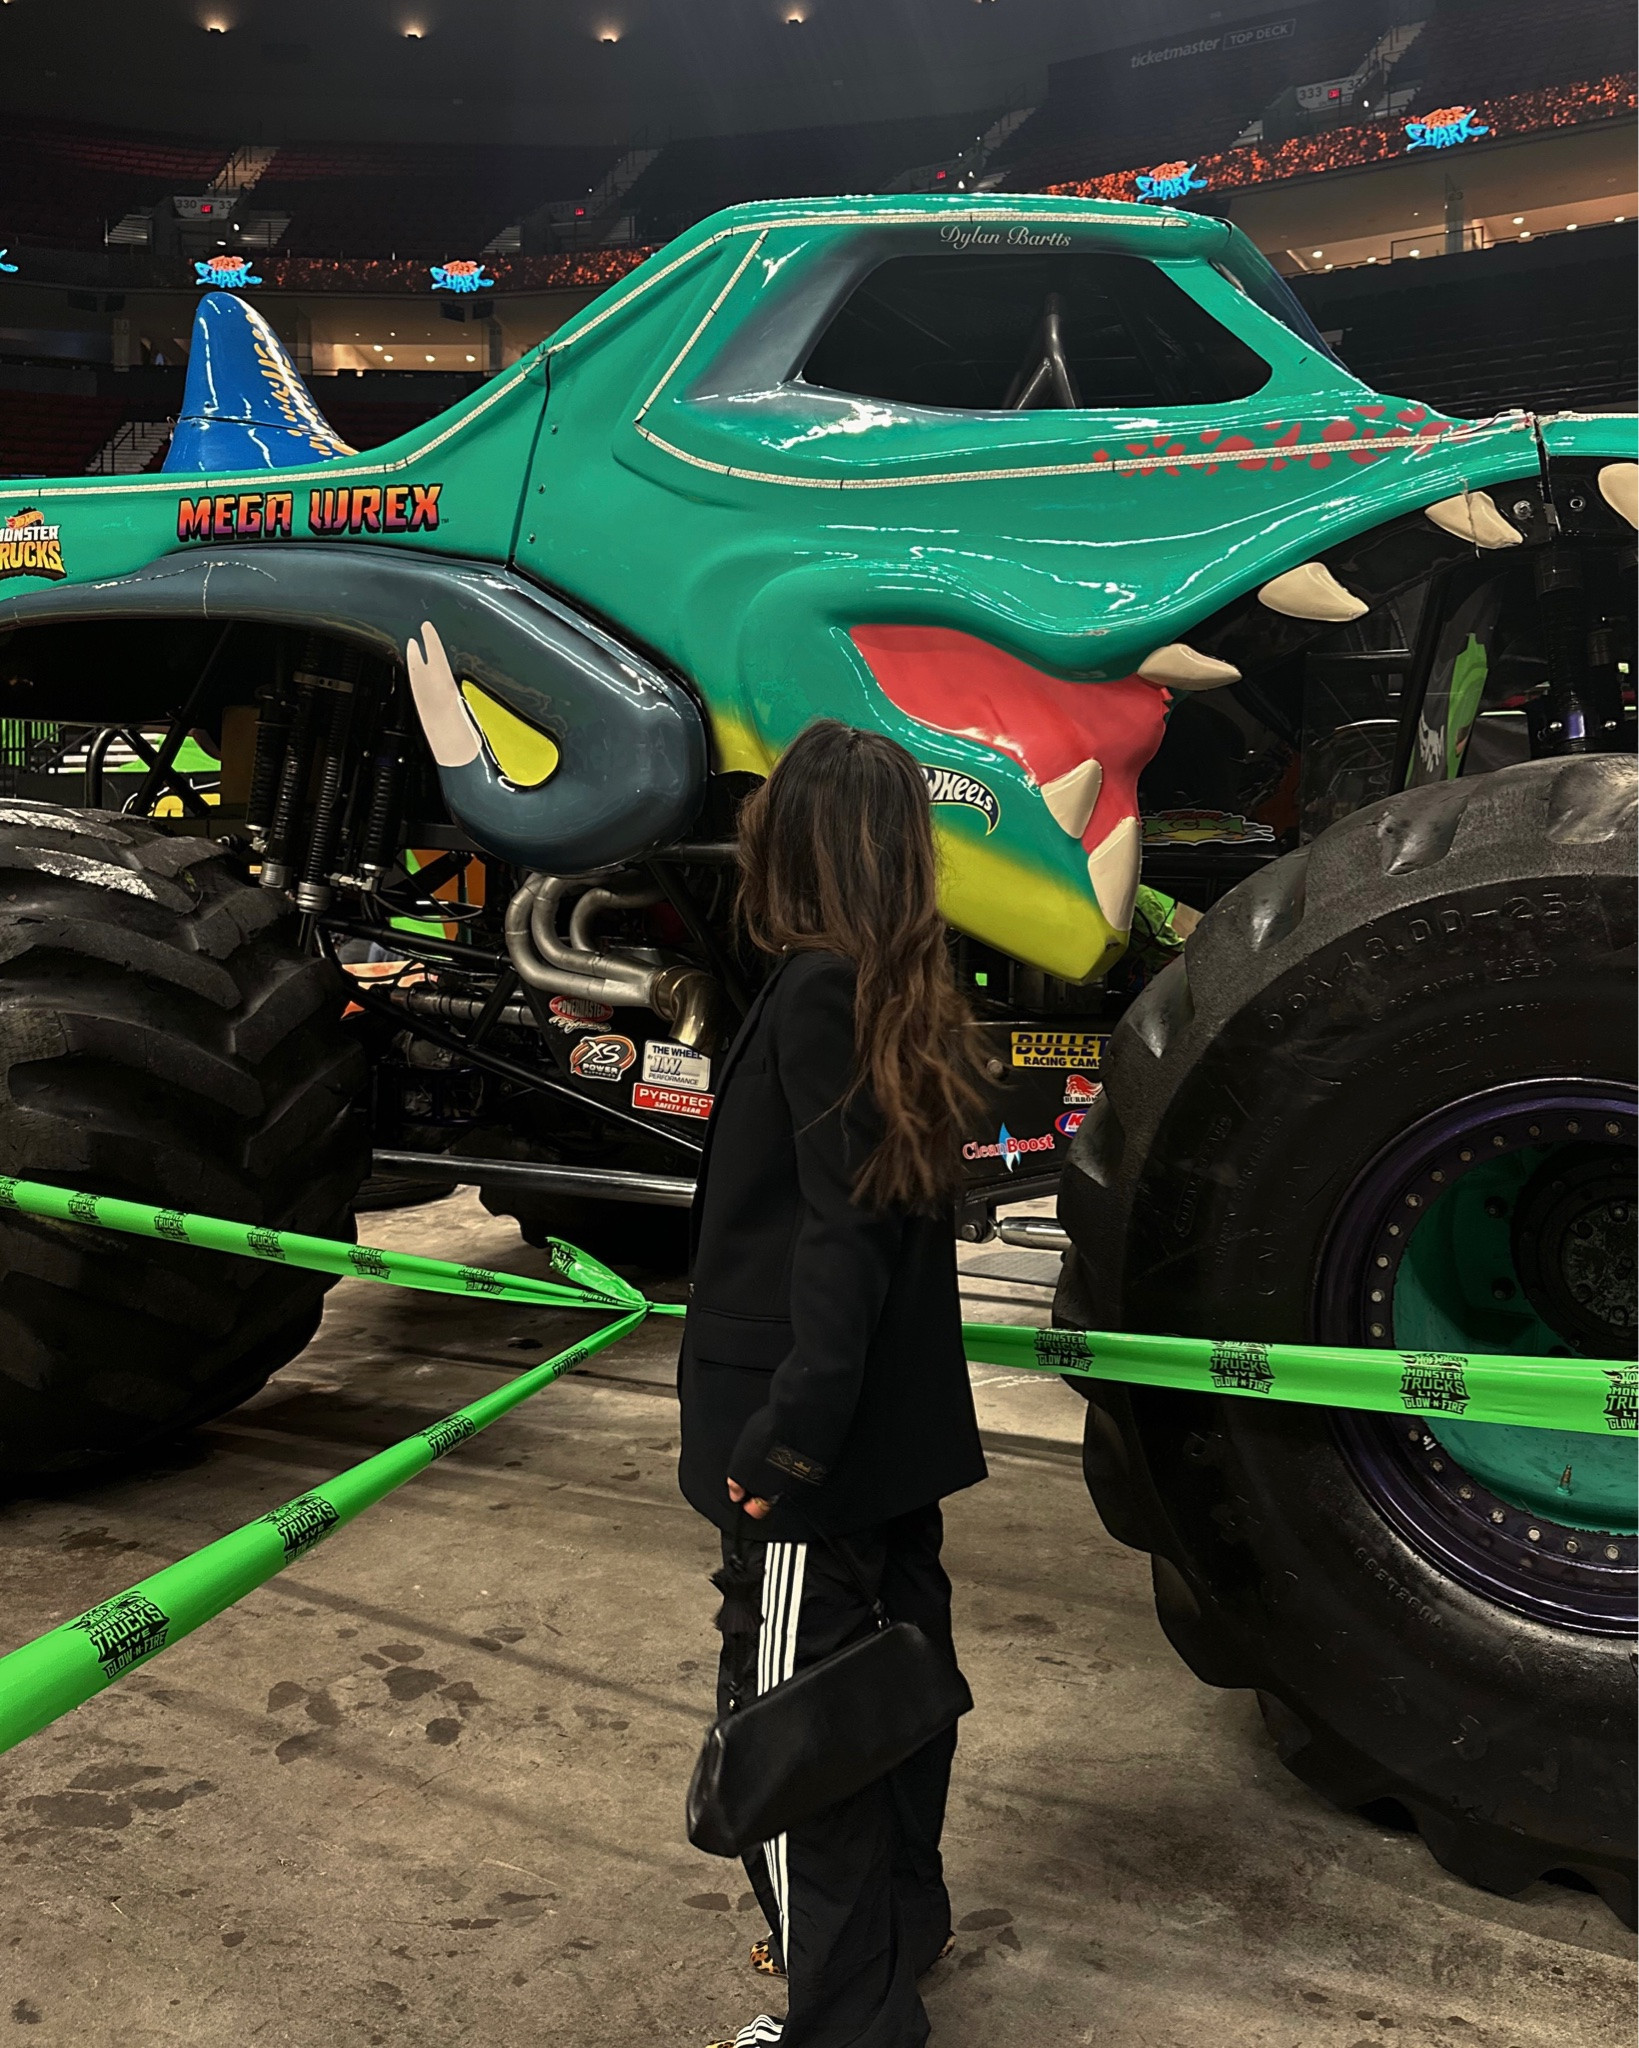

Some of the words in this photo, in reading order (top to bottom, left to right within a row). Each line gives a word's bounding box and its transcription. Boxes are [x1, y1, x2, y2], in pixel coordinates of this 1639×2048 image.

[1230, 34, 1252, 46] TOP
[1256, 24, 1288, 41] DECK
[1130, 38, 1221, 68] ticketmaster
[1299, 87, 1322, 101] 333
[1405, 109, 1489, 151] SHARK
[1136, 163, 1208, 202] SHARK
[941, 225, 1000, 250] Dylan
[194, 261, 262, 288] SHARK
[430, 265, 494, 293] SHARK
[177, 491, 293, 541] MEGA
[308, 484, 443, 536] WREX
[0, 540, 66, 574] RUCKS
[575, 1041, 621, 1064] XS
[652, 1045, 670, 1056] THE
[1023, 1056, 1066, 1066] RACING
[582, 1063, 618, 1075] POWER
[648, 1073, 699, 1086] PERFORMANCE
[655, 1101, 681, 1111] SAFETY
[681, 1105, 702, 1115] GEAR
[1038, 1333, 1085, 1344] MONSTER
[1212, 1357, 1271, 1376] TRUCKS
[1214, 1349, 1266, 1362] MONSTER
[1226, 1370, 1257, 1378] LIVE
[1406, 1368, 1462, 1380] MONSTER
[1403, 1376, 1466, 1397] TRUCKS
[1418, 1390, 1451, 1399] LIVE
[429, 1419, 474, 1457] TRUCKS
[277, 1497, 325, 1527] MONSTER
[280, 1502, 336, 1548] TRUCKS
[299, 1523, 325, 1543] LIVE
[89, 1598, 149, 1636] MONSTER
[92, 1604, 164, 1656] TRUCKS
[117, 1627, 151, 1653] LIVE
